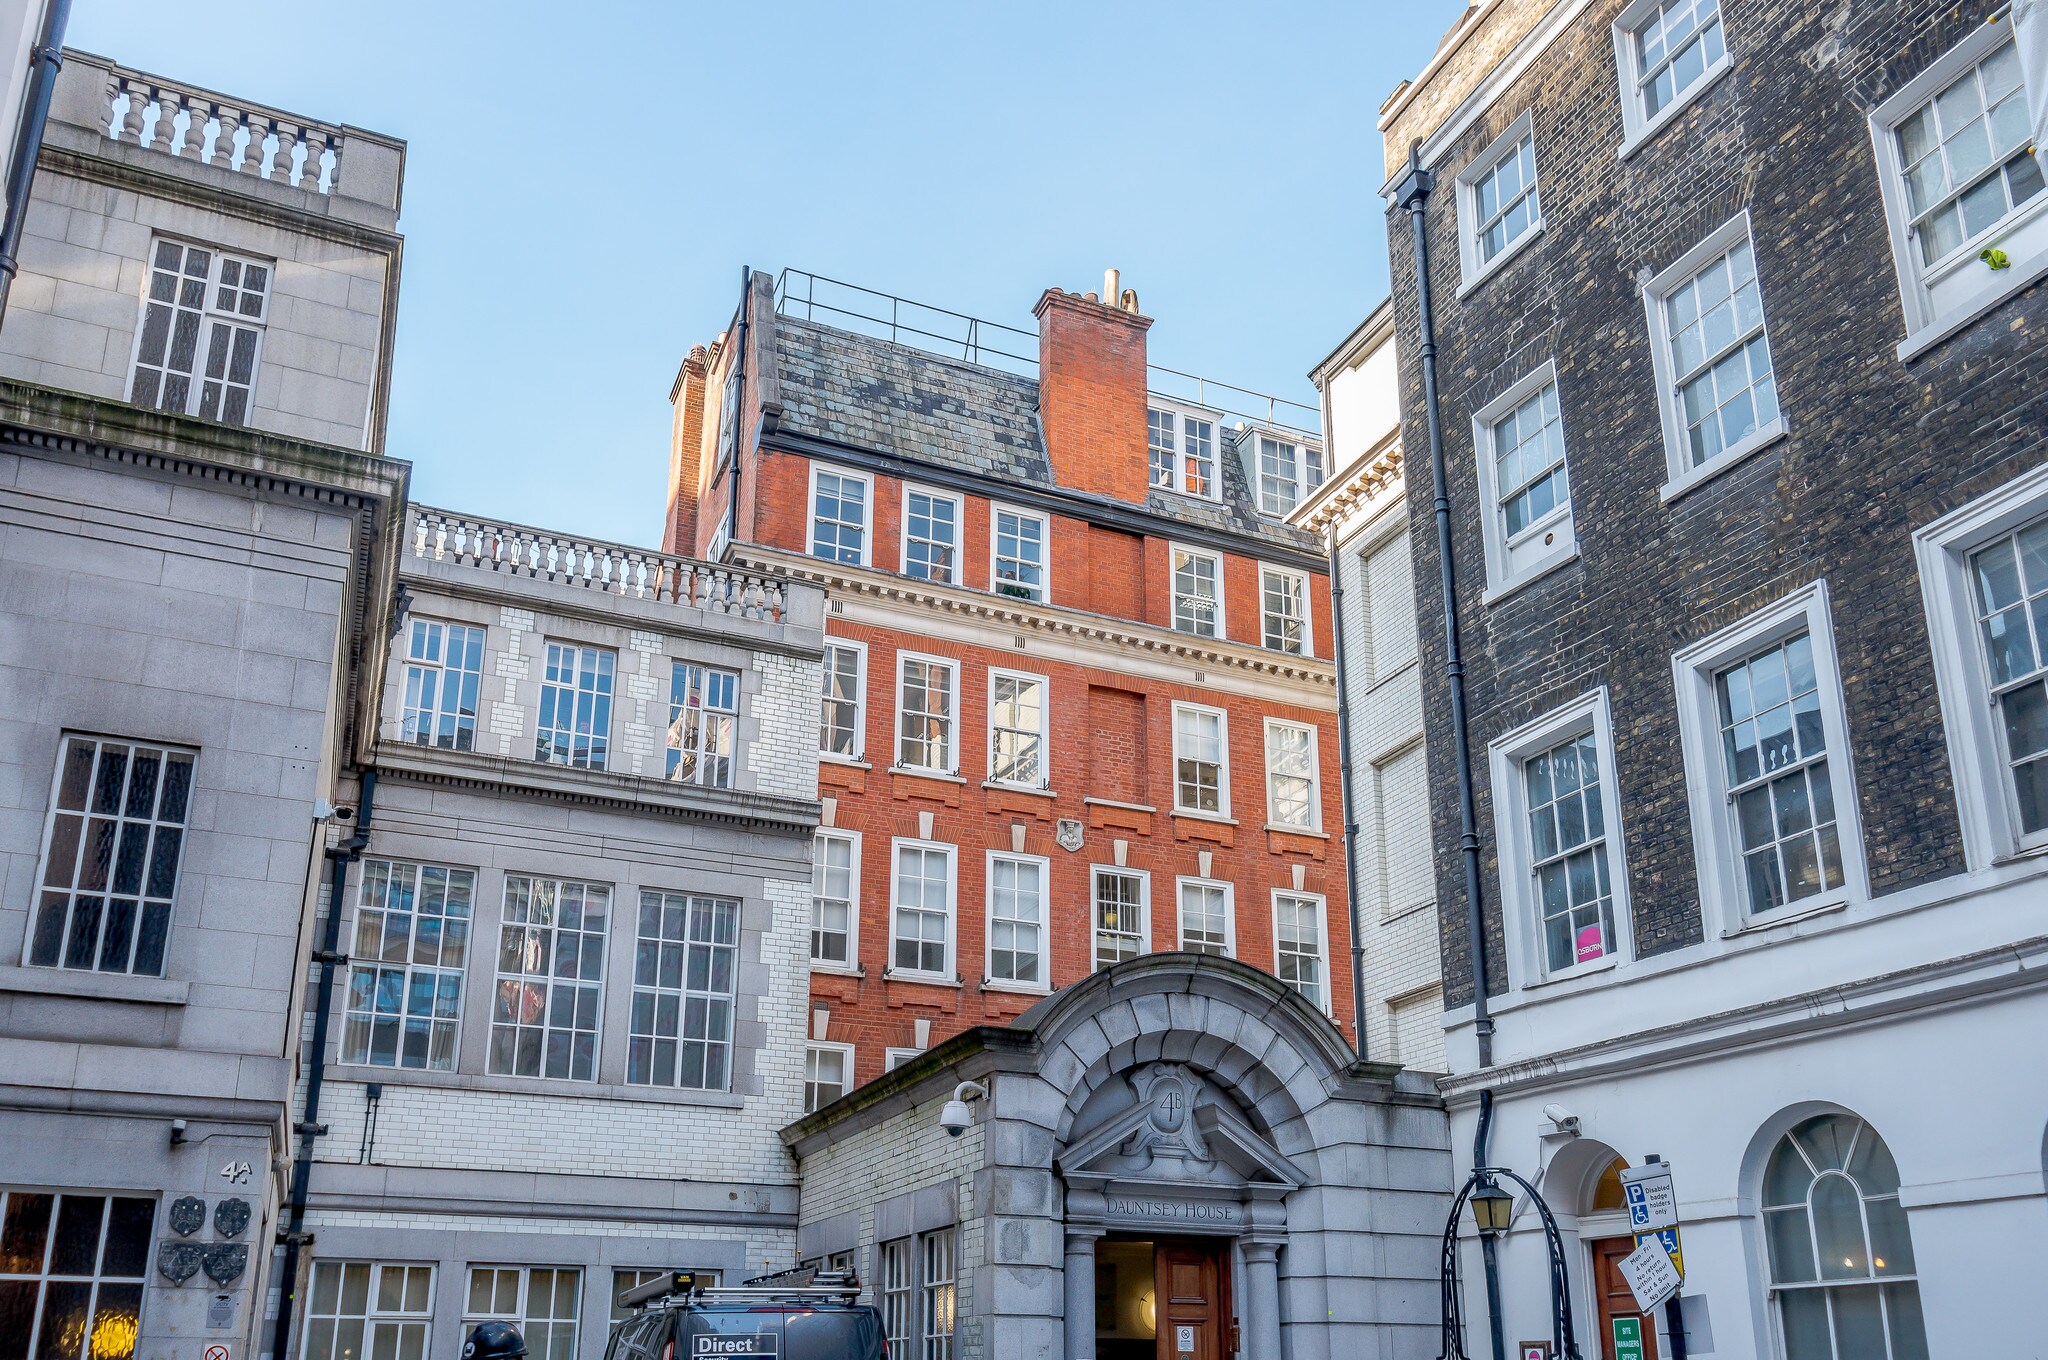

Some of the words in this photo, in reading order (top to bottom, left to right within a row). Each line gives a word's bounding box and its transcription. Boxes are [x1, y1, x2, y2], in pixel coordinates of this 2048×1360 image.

[1160, 1092, 1182, 1121] 4B
[1645, 1184, 1670, 1194] Disabled
[1650, 1193, 1667, 1201] badge
[1106, 1198, 1180, 1217] DAUNTSEY
[1185, 1203, 1233, 1220] HOUSE
[1650, 1200, 1671, 1208] holders
[1630, 1254, 1642, 1265] Mon
[1643, 1244, 1651, 1254] Fri
[1640, 1254, 1655, 1268] hours
[1636, 1273, 1646, 1282] No
[1645, 1259, 1662, 1275] return
[1636, 1276, 1652, 1291] within
[1656, 1263, 1668, 1275] hour
[1643, 1287, 1653, 1296] Sat
[1657, 1273, 1669, 1284] Sun
[1649, 1293, 1659, 1302] No
[1659, 1283, 1671, 1295] limit
[1622, 1327, 1632, 1335] SITE
[699, 1337, 753, 1353] Direct
